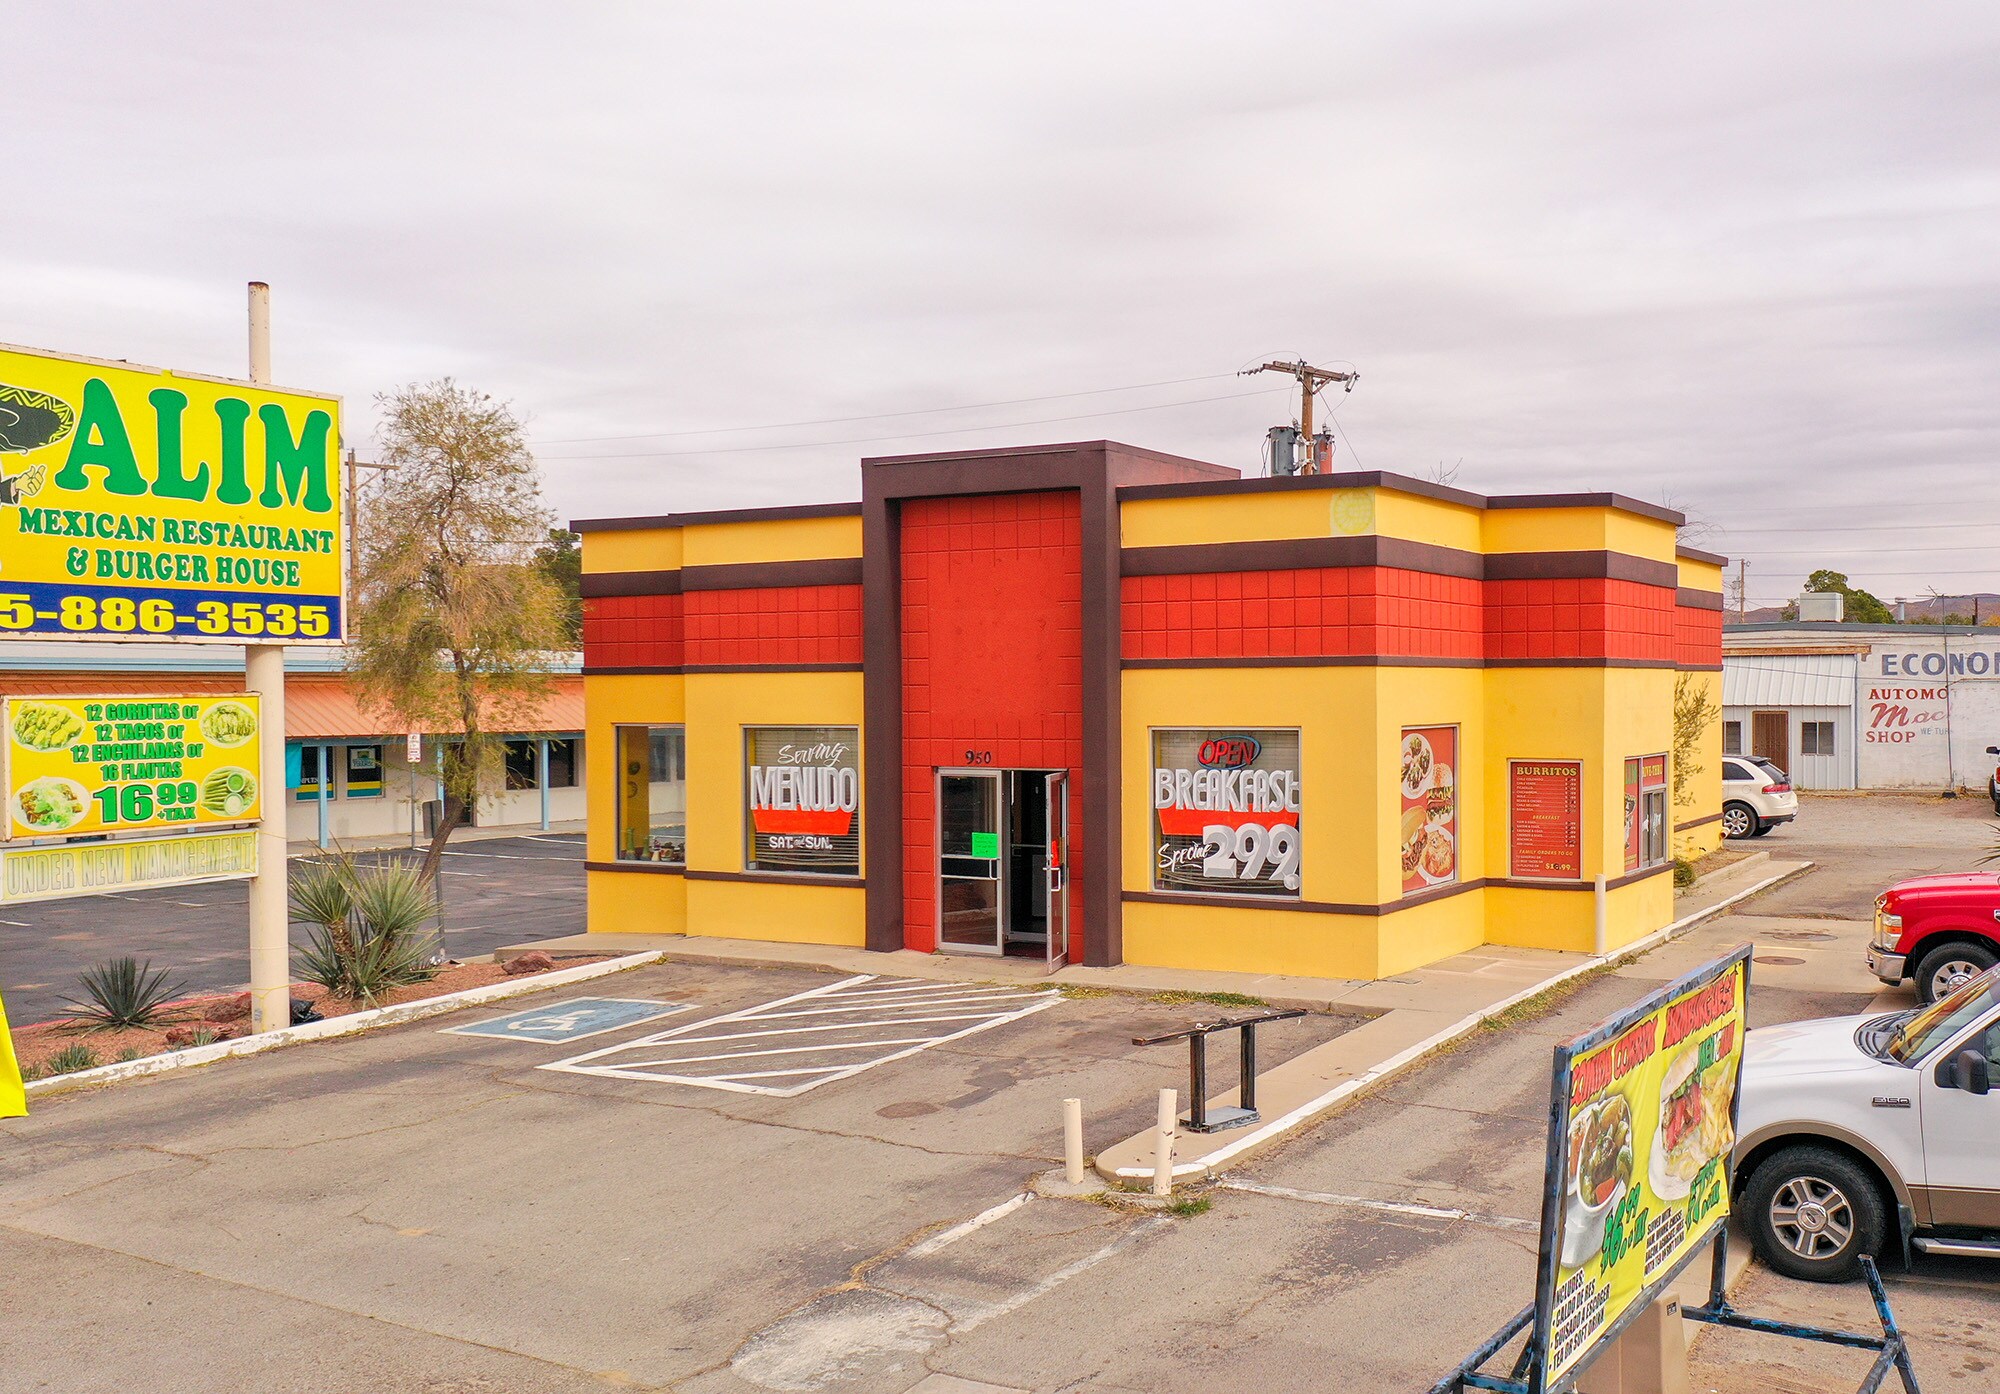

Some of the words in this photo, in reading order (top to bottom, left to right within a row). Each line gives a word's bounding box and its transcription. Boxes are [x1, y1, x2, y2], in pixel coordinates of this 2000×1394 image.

[54, 377, 333, 513] ALIM
[18, 507, 156, 542] MEXICAN
[162, 518, 334, 554] RESTAURANT
[66, 547, 89, 577] &
[95, 549, 210, 583] BURGER
[216, 556, 300, 587] HOUSE
[84, 704, 103, 721] 12
[105, 703, 180, 721] GORDITAS
[182, 704, 199, 720] or
[94, 724, 112, 742] 12
[115, 723, 165, 741] TACOS
[168, 724, 184, 740] or
[1866, 731, 1915, 743] SHOP
[70, 745, 90, 763] 12
[92, 742, 186, 762] ENCHILADAS
[187, 743, 204, 758] or
[777, 742, 850, 767] Serving
[965, 749, 992, 765] 950
[1198, 739, 1256, 766] OPEN
[100, 764, 119, 782] 16
[121, 762, 183, 780] FLAUTAS
[1516, 766, 1577, 777] BURRITOS
[750, 765, 857, 813] MENUDO
[1155, 768, 1300, 814] BREAKFAST
[93, 784, 154, 823] 16
[157, 783, 197, 806] 99
[157, 807, 196, 822] +TAX
[769, 836, 794, 849] SAT.
[805, 836, 833, 850] SUN.
[7, 852, 75, 896] UNDER
[81, 847, 125, 888] NEW
[131, 835, 253, 882] MANAGEMENT
[1157, 841, 1213, 873] Special
